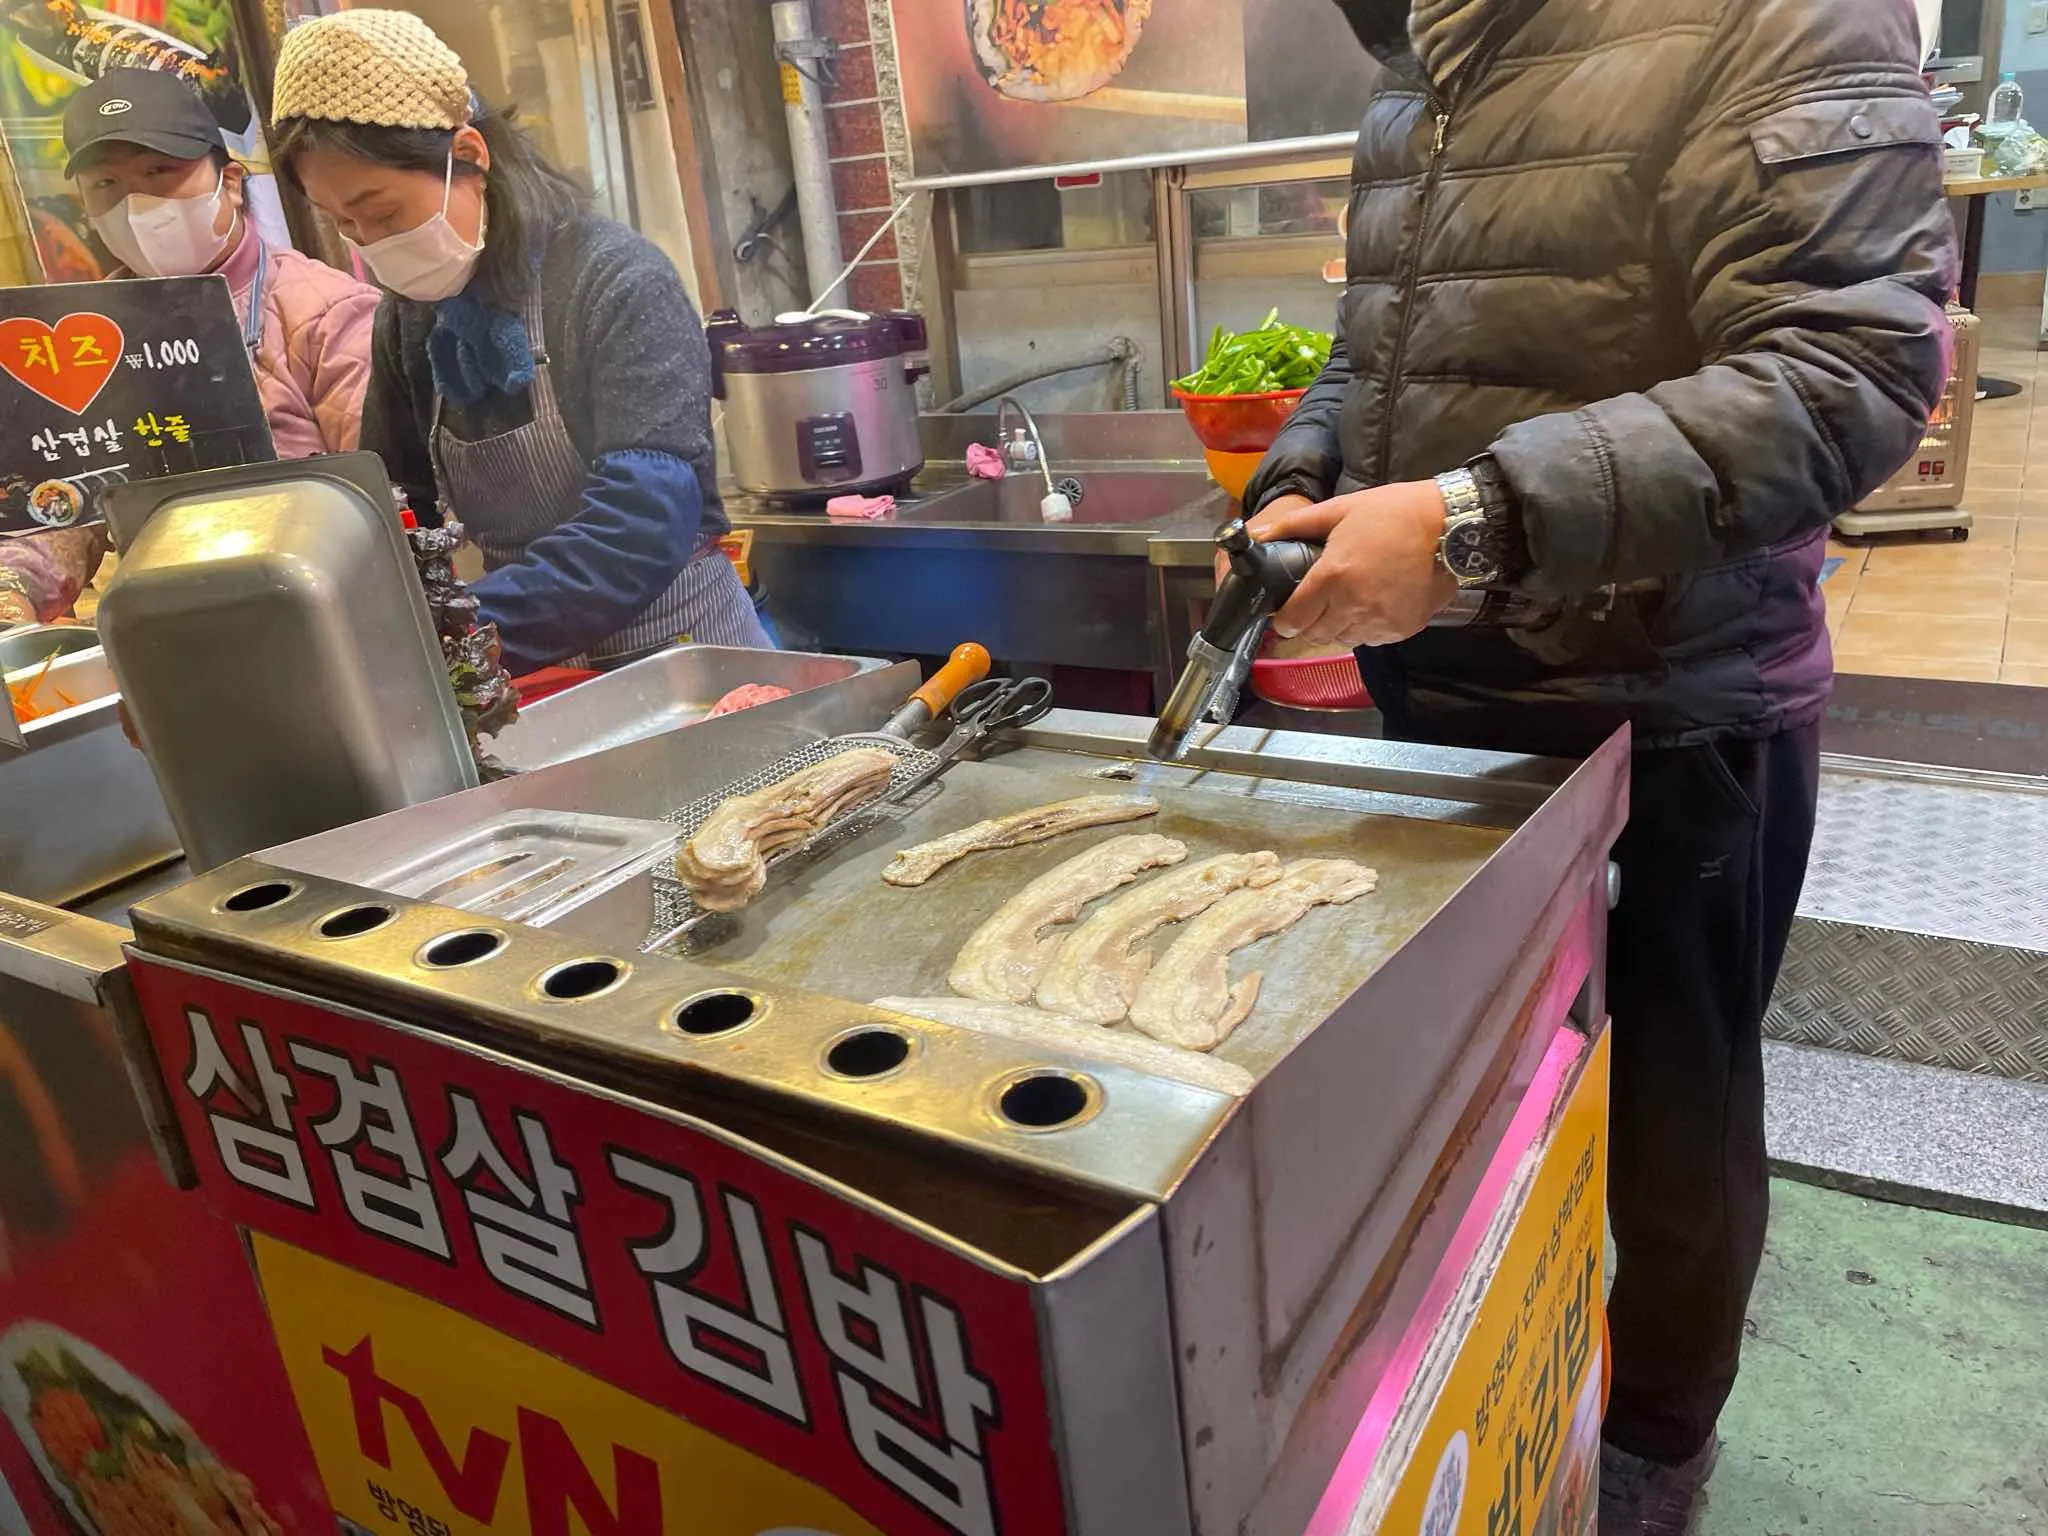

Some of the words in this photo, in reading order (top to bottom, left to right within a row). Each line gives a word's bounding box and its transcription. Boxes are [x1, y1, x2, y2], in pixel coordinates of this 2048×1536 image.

[19, 335, 110, 375] 치즈
[31, 418, 123, 462] 삼겹살
[186, 1010, 598, 1330] 삼겹살
[610, 1147, 997, 1536] 김밥
